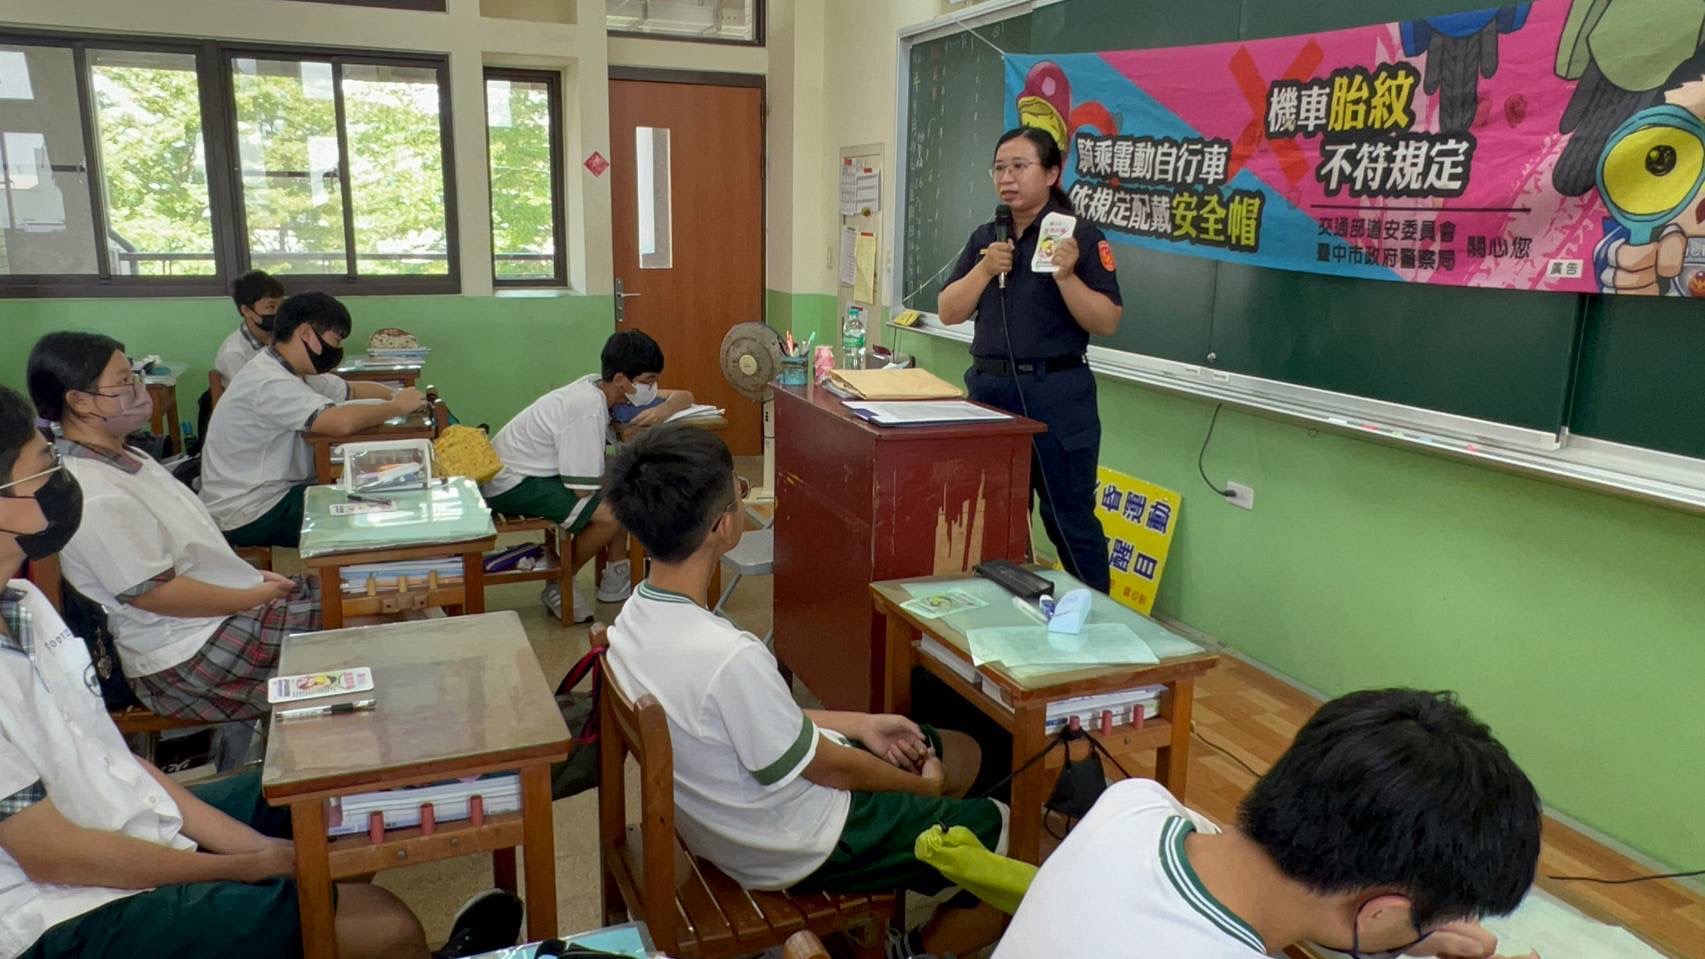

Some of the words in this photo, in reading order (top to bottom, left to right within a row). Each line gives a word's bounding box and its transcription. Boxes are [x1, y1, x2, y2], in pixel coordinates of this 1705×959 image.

[1268, 70, 1414, 133] 機車胎紋
[1076, 137, 1229, 186] 騎乘電動自行車
[1320, 138, 1470, 192] 不符規定
[1069, 184, 1262, 248] 依規定配戴安全帽
[1317, 217, 1457, 243] 交通部道安委員會
[1467, 236, 1533, 259] 關心您
[1094, 480, 1171, 534] 昏運動
[1105, 536, 1158, 580] 醒目
